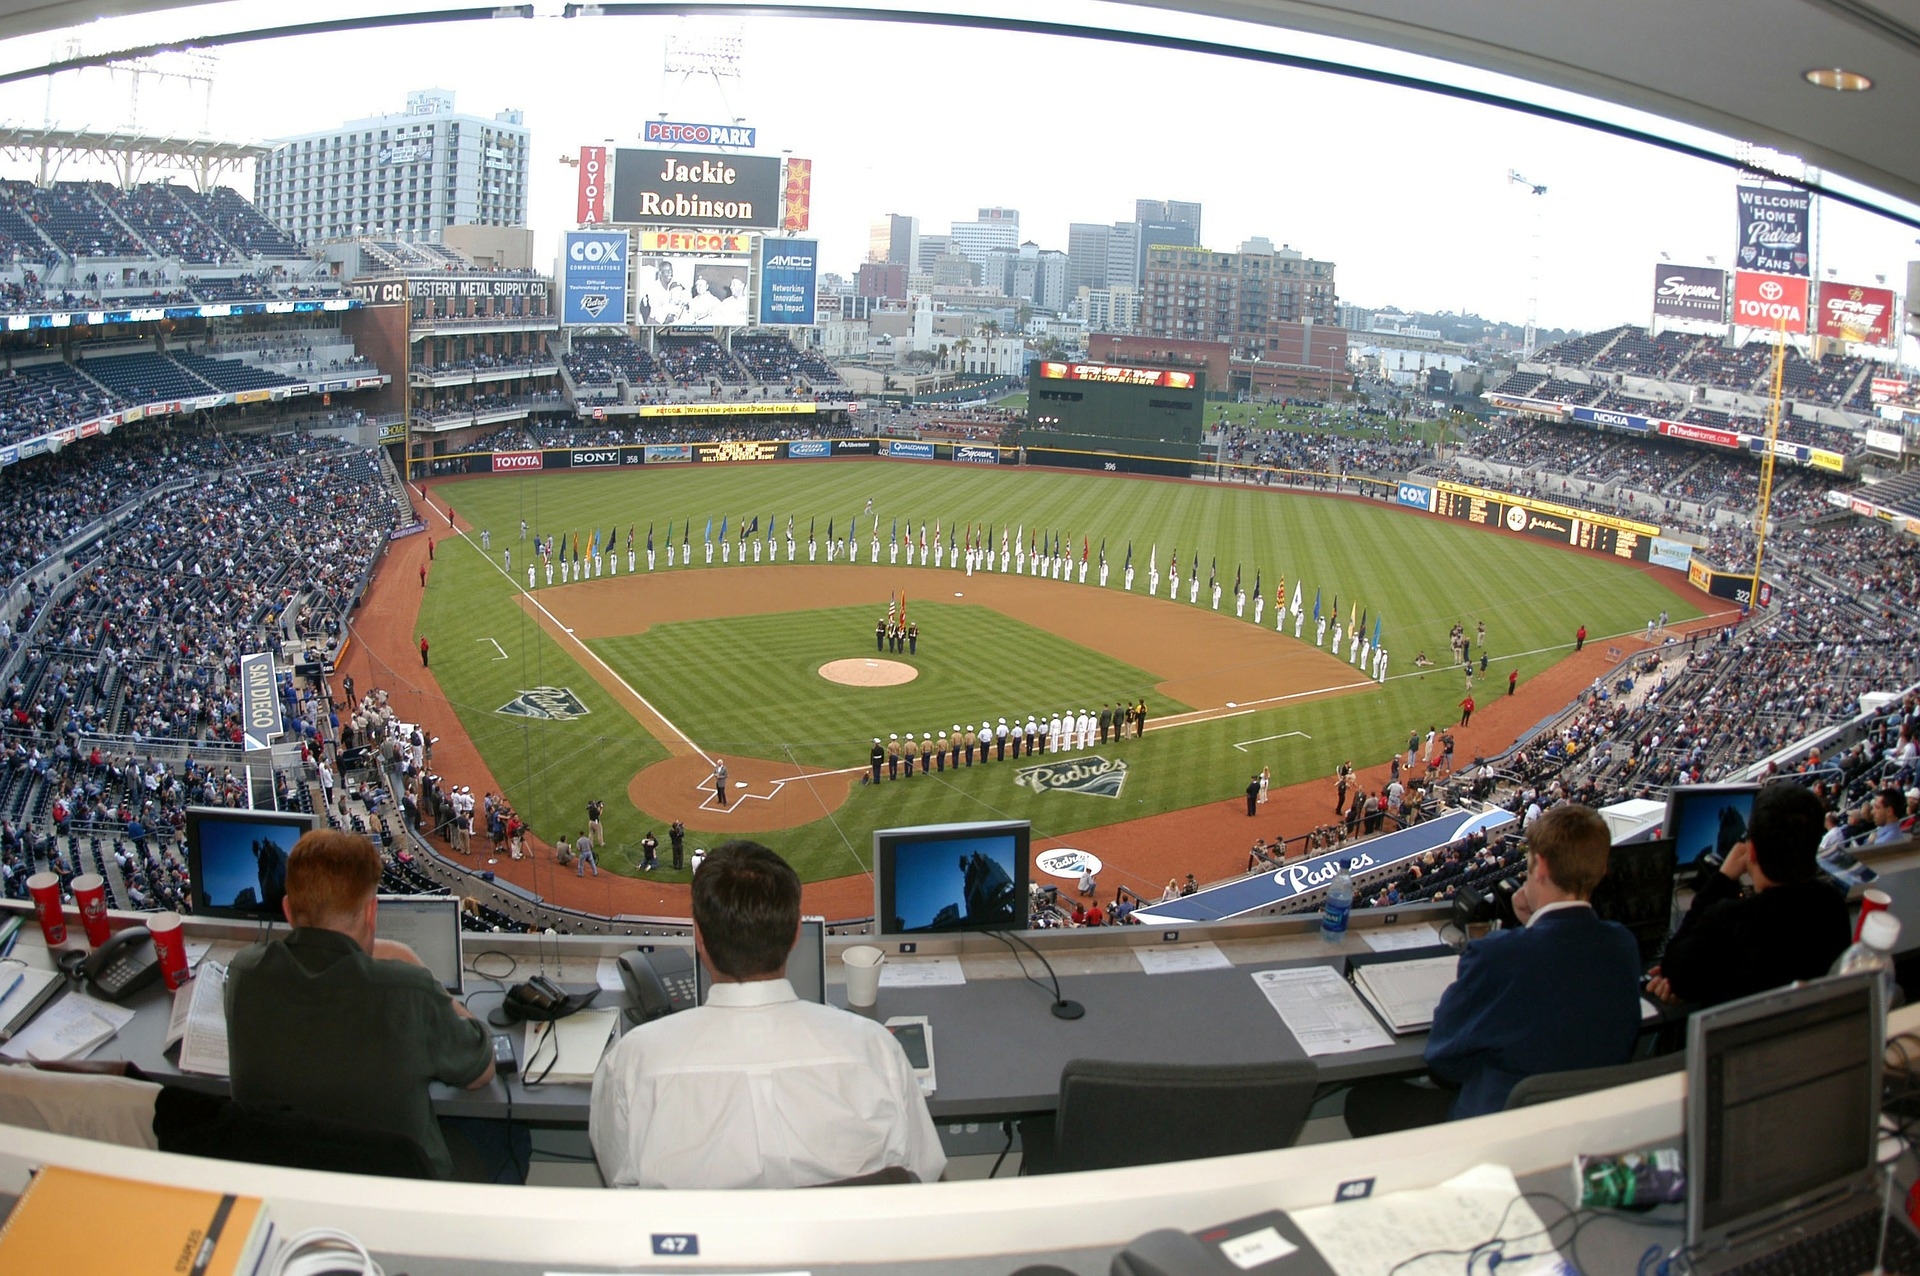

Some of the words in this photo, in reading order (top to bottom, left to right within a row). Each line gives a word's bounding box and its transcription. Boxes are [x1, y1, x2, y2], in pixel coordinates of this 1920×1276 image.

[649, 123, 710, 142] PETCO
[710, 127, 752, 146] PARK
[660, 158, 736, 185] Jackie
[585, 148, 599, 222] TOYOTA
[639, 191, 753, 219] Robinson
[1740, 192, 1808, 210] WELCOME
[1753, 208, 1796, 223] HOME
[656, 233, 723, 250] PETCO
[1748, 221, 1802, 246] Padres
[570, 240, 622, 264] COX
[767, 255, 812, 267] AMCC
[1757, 256, 1791, 270] FANS
[408, 281, 456, 297] WESTERN
[460, 282, 491, 296] METAL
[493, 283, 528, 297] SUPPLY
[531, 284, 546, 297] CO.
[772, 283, 805, 294] Networking
[1657, 276, 1721, 301] Sycuan
[580, 296, 610, 310] Padres
[773, 293, 803, 302] Innovation
[1657, 298, 1684, 306] CASINO
[1693, 302, 1720, 310] RESORT
[784, 304, 805, 313] Impact
[1739, 300, 1801, 321] TOYOTA
[1827, 298, 1885, 316] GAME
[1832, 309, 1877, 325] TIME
[1075, 365, 1121, 375] GAME
[1124, 367, 1161, 379] TIME
[1080, 373, 1155, 385] BUDWEISER
[722, 406, 737, 414] pets
[1593, 412, 1629, 426] NOKIA
[894, 442, 930, 451] QUALCOMM
[957, 447, 995, 459] Sycuan
[495, 456, 540, 468] TOYOTA
[573, 452, 617, 463] SONY
[626, 455, 639, 464] 358
[1104, 462, 1116, 470] 396
[1400, 486, 1428, 505] COX
[1510, 513, 1524, 524] 42
[1735, 589, 1751, 602] 322
[249, 663, 270, 687] SAN
[251, 688, 275, 728] DIEGO
[514, 686, 579, 720] Padres
[1014, 758, 1128, 795] Padres
[1043, 854, 1090, 873] Padres
[1166, 932, 1176, 940] 10
[1341, 1181, 1368, 1197] 48
[174, 1229, 203, 1273] STAPLES
[660, 1237, 689, 1253] 47
